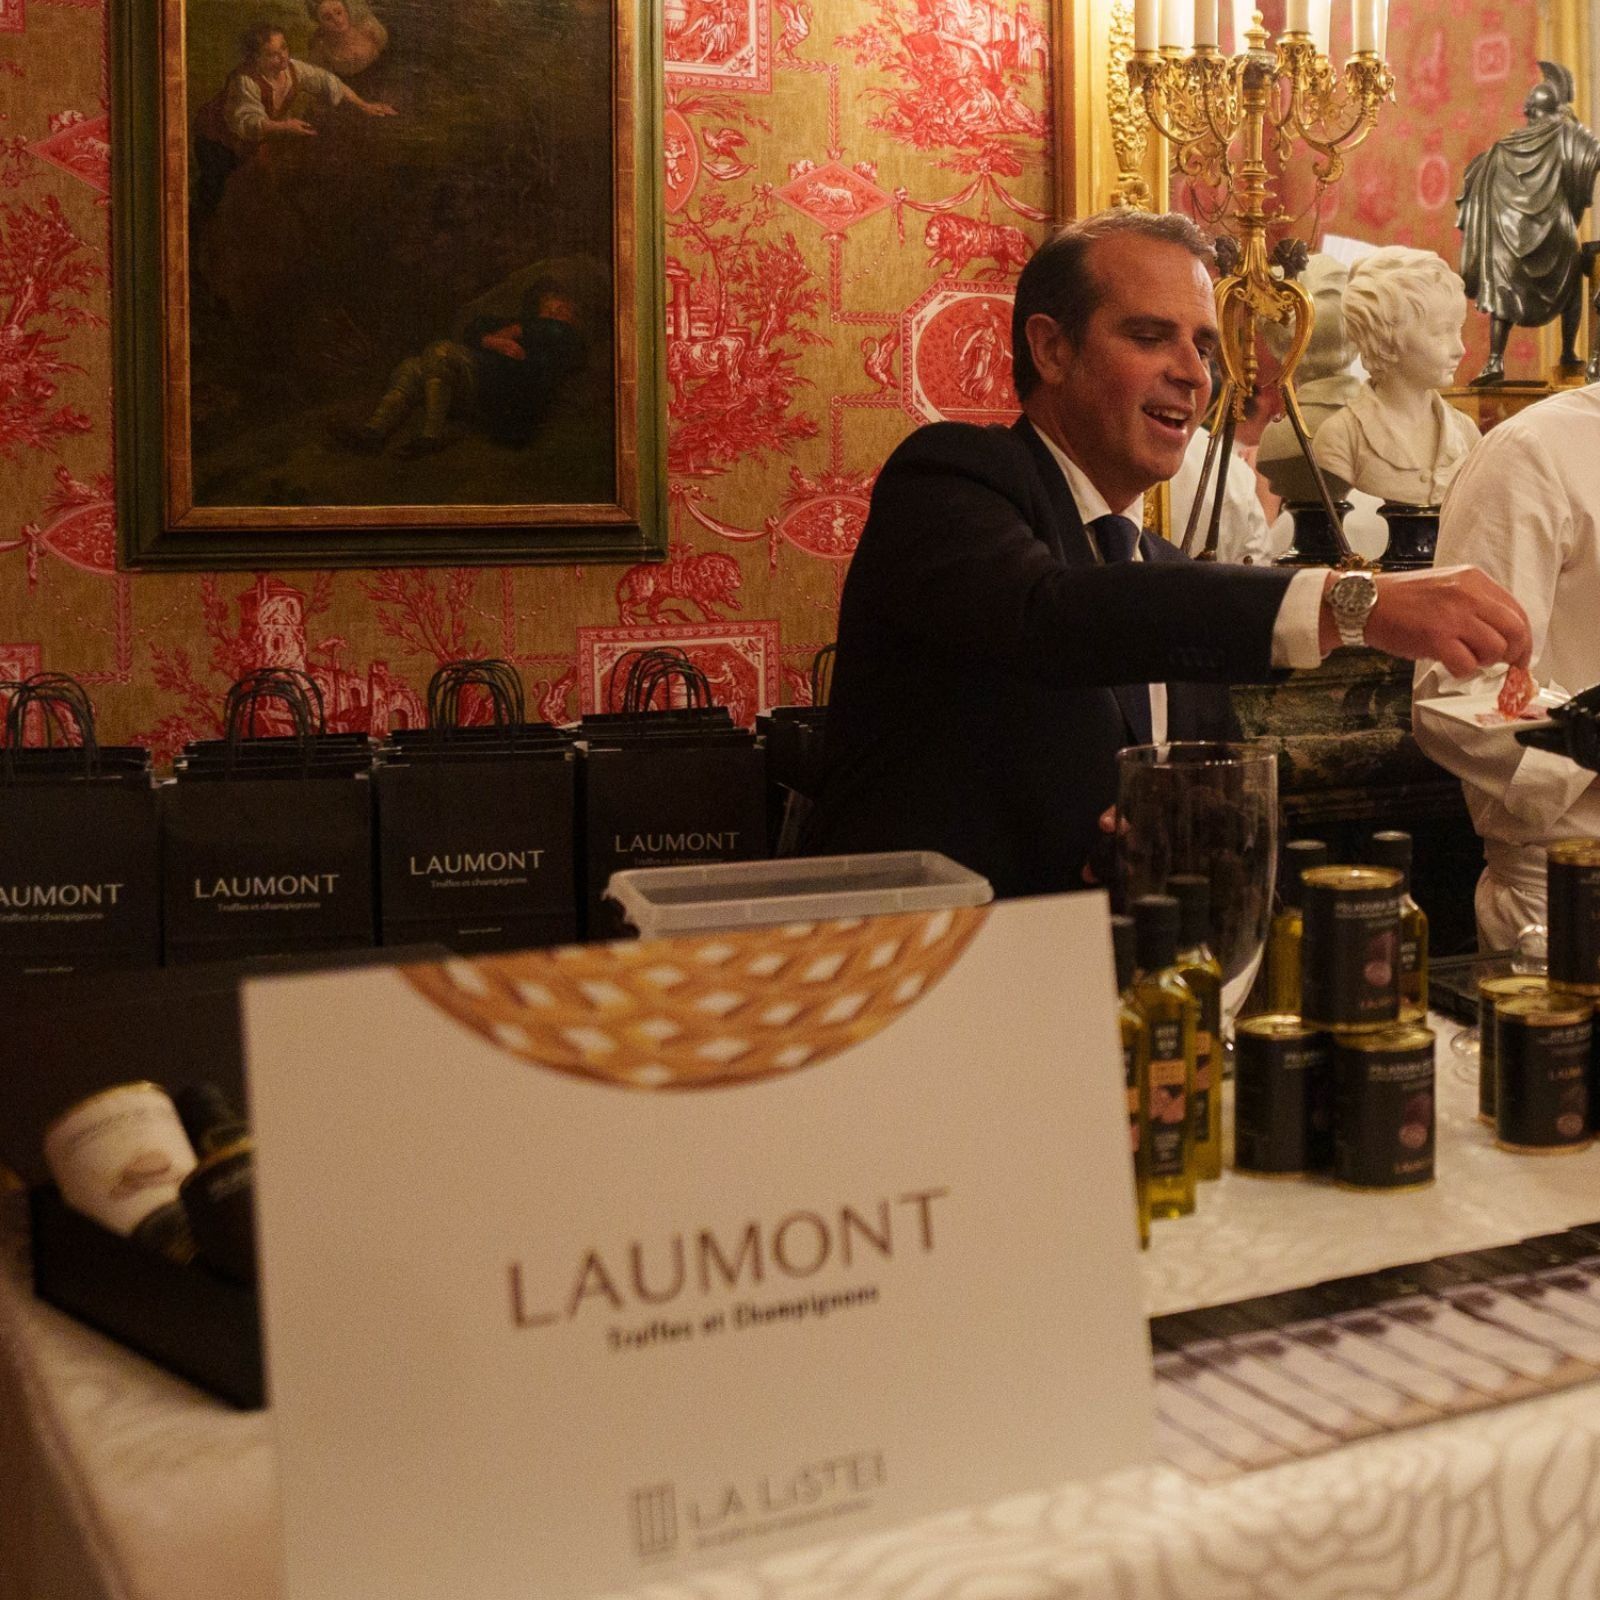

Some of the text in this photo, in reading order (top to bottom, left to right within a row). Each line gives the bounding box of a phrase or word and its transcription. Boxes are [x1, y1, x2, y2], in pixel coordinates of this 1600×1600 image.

[614, 832, 740, 853] LAUMONT
[410, 850, 545, 875] LAUMONT
[194, 874, 340, 899] LAUMONT
[509, 1186, 949, 1330] LAUMONT
[607, 1321, 693, 1349] Truffes
[687, 1482, 746, 1530] LA
